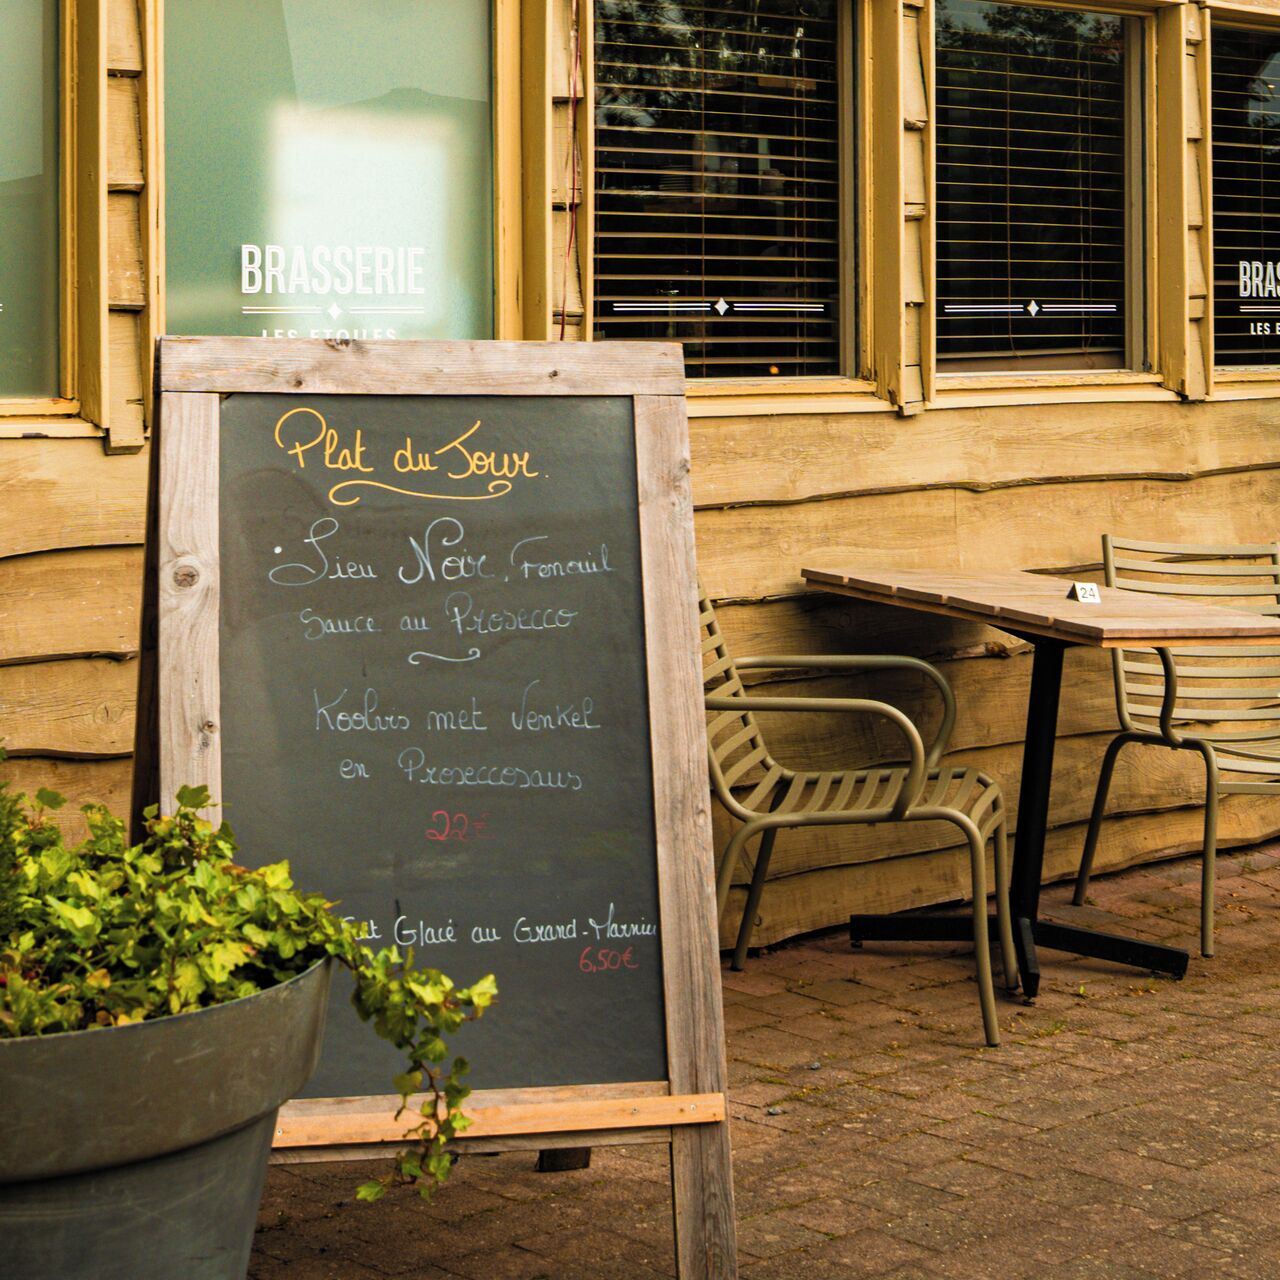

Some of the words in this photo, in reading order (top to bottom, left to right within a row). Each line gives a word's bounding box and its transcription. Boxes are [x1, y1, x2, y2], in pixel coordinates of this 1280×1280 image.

[240, 244, 425, 295] BRASSERIE
[1250, 322, 1271, 335] LES
[275, 407, 374, 472] Plat
[393, 437, 438, 473] du
[1079, 586, 1096, 599] 24
[299, 608, 382, 640] Sauce
[399, 614, 432, 631] au
[445, 591, 579, 635] Prosecco
[312, 687, 411, 733] Koolvis
[426, 696, 489, 732] met
[339, 758, 371, 780] en
[397, 746, 584, 791] Proseccosaus
[470, 927, 502, 943] au
[578, 946, 639, 974] 6,50€
